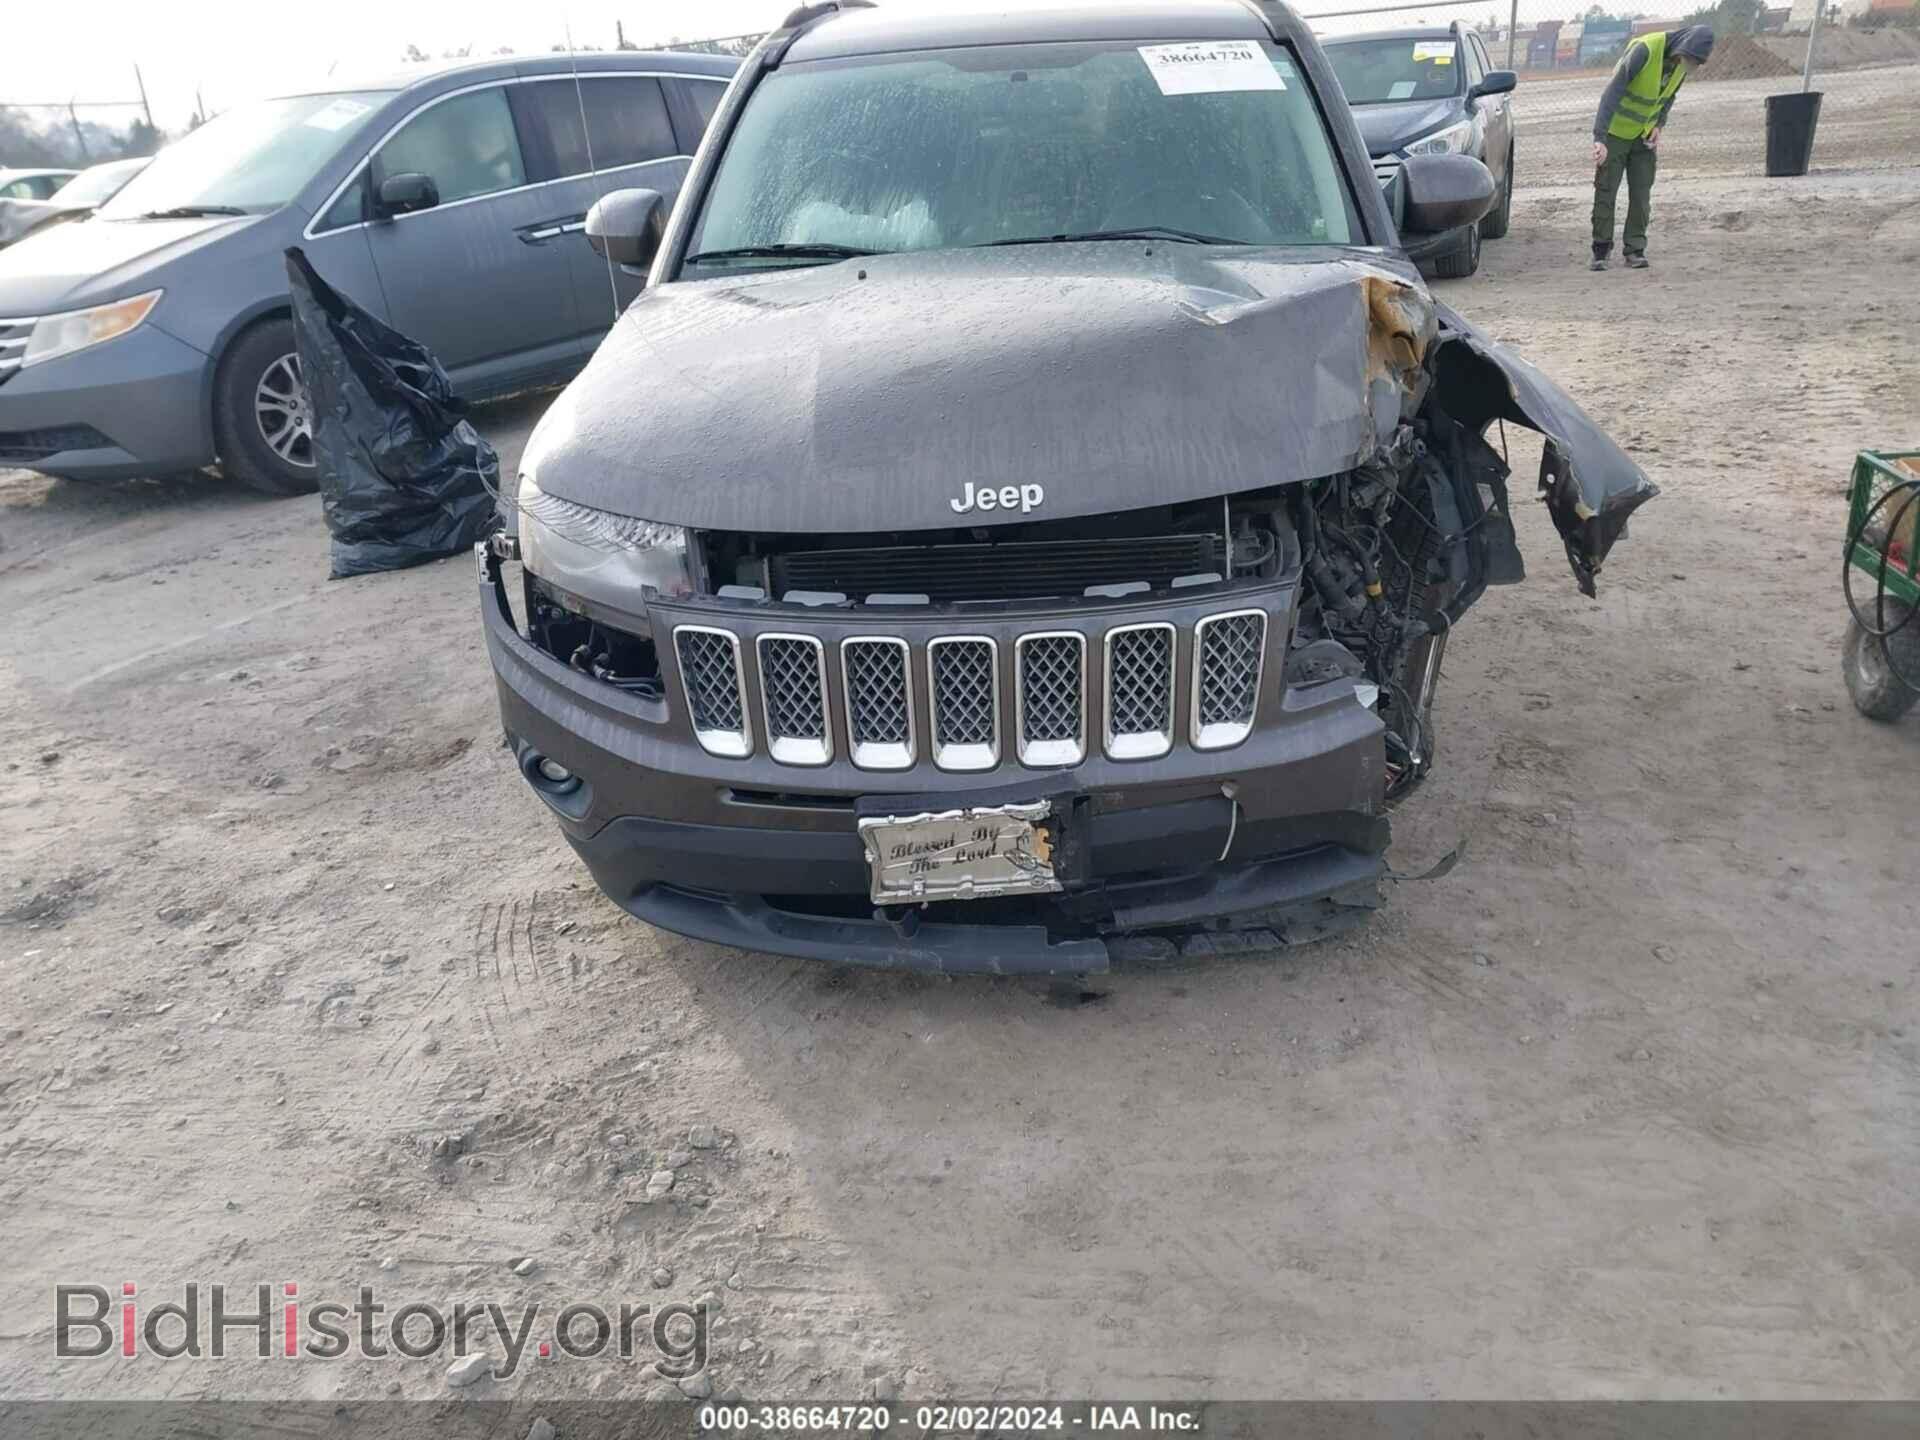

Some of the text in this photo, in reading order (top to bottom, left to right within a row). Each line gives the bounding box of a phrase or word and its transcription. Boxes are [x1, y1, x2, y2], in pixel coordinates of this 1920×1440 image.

[1159, 50, 1253, 65] 38664720
[950, 482, 1044, 513] Jeep
[890, 826, 999, 860] Blessed By
[909, 841, 997, 874] The Lord
